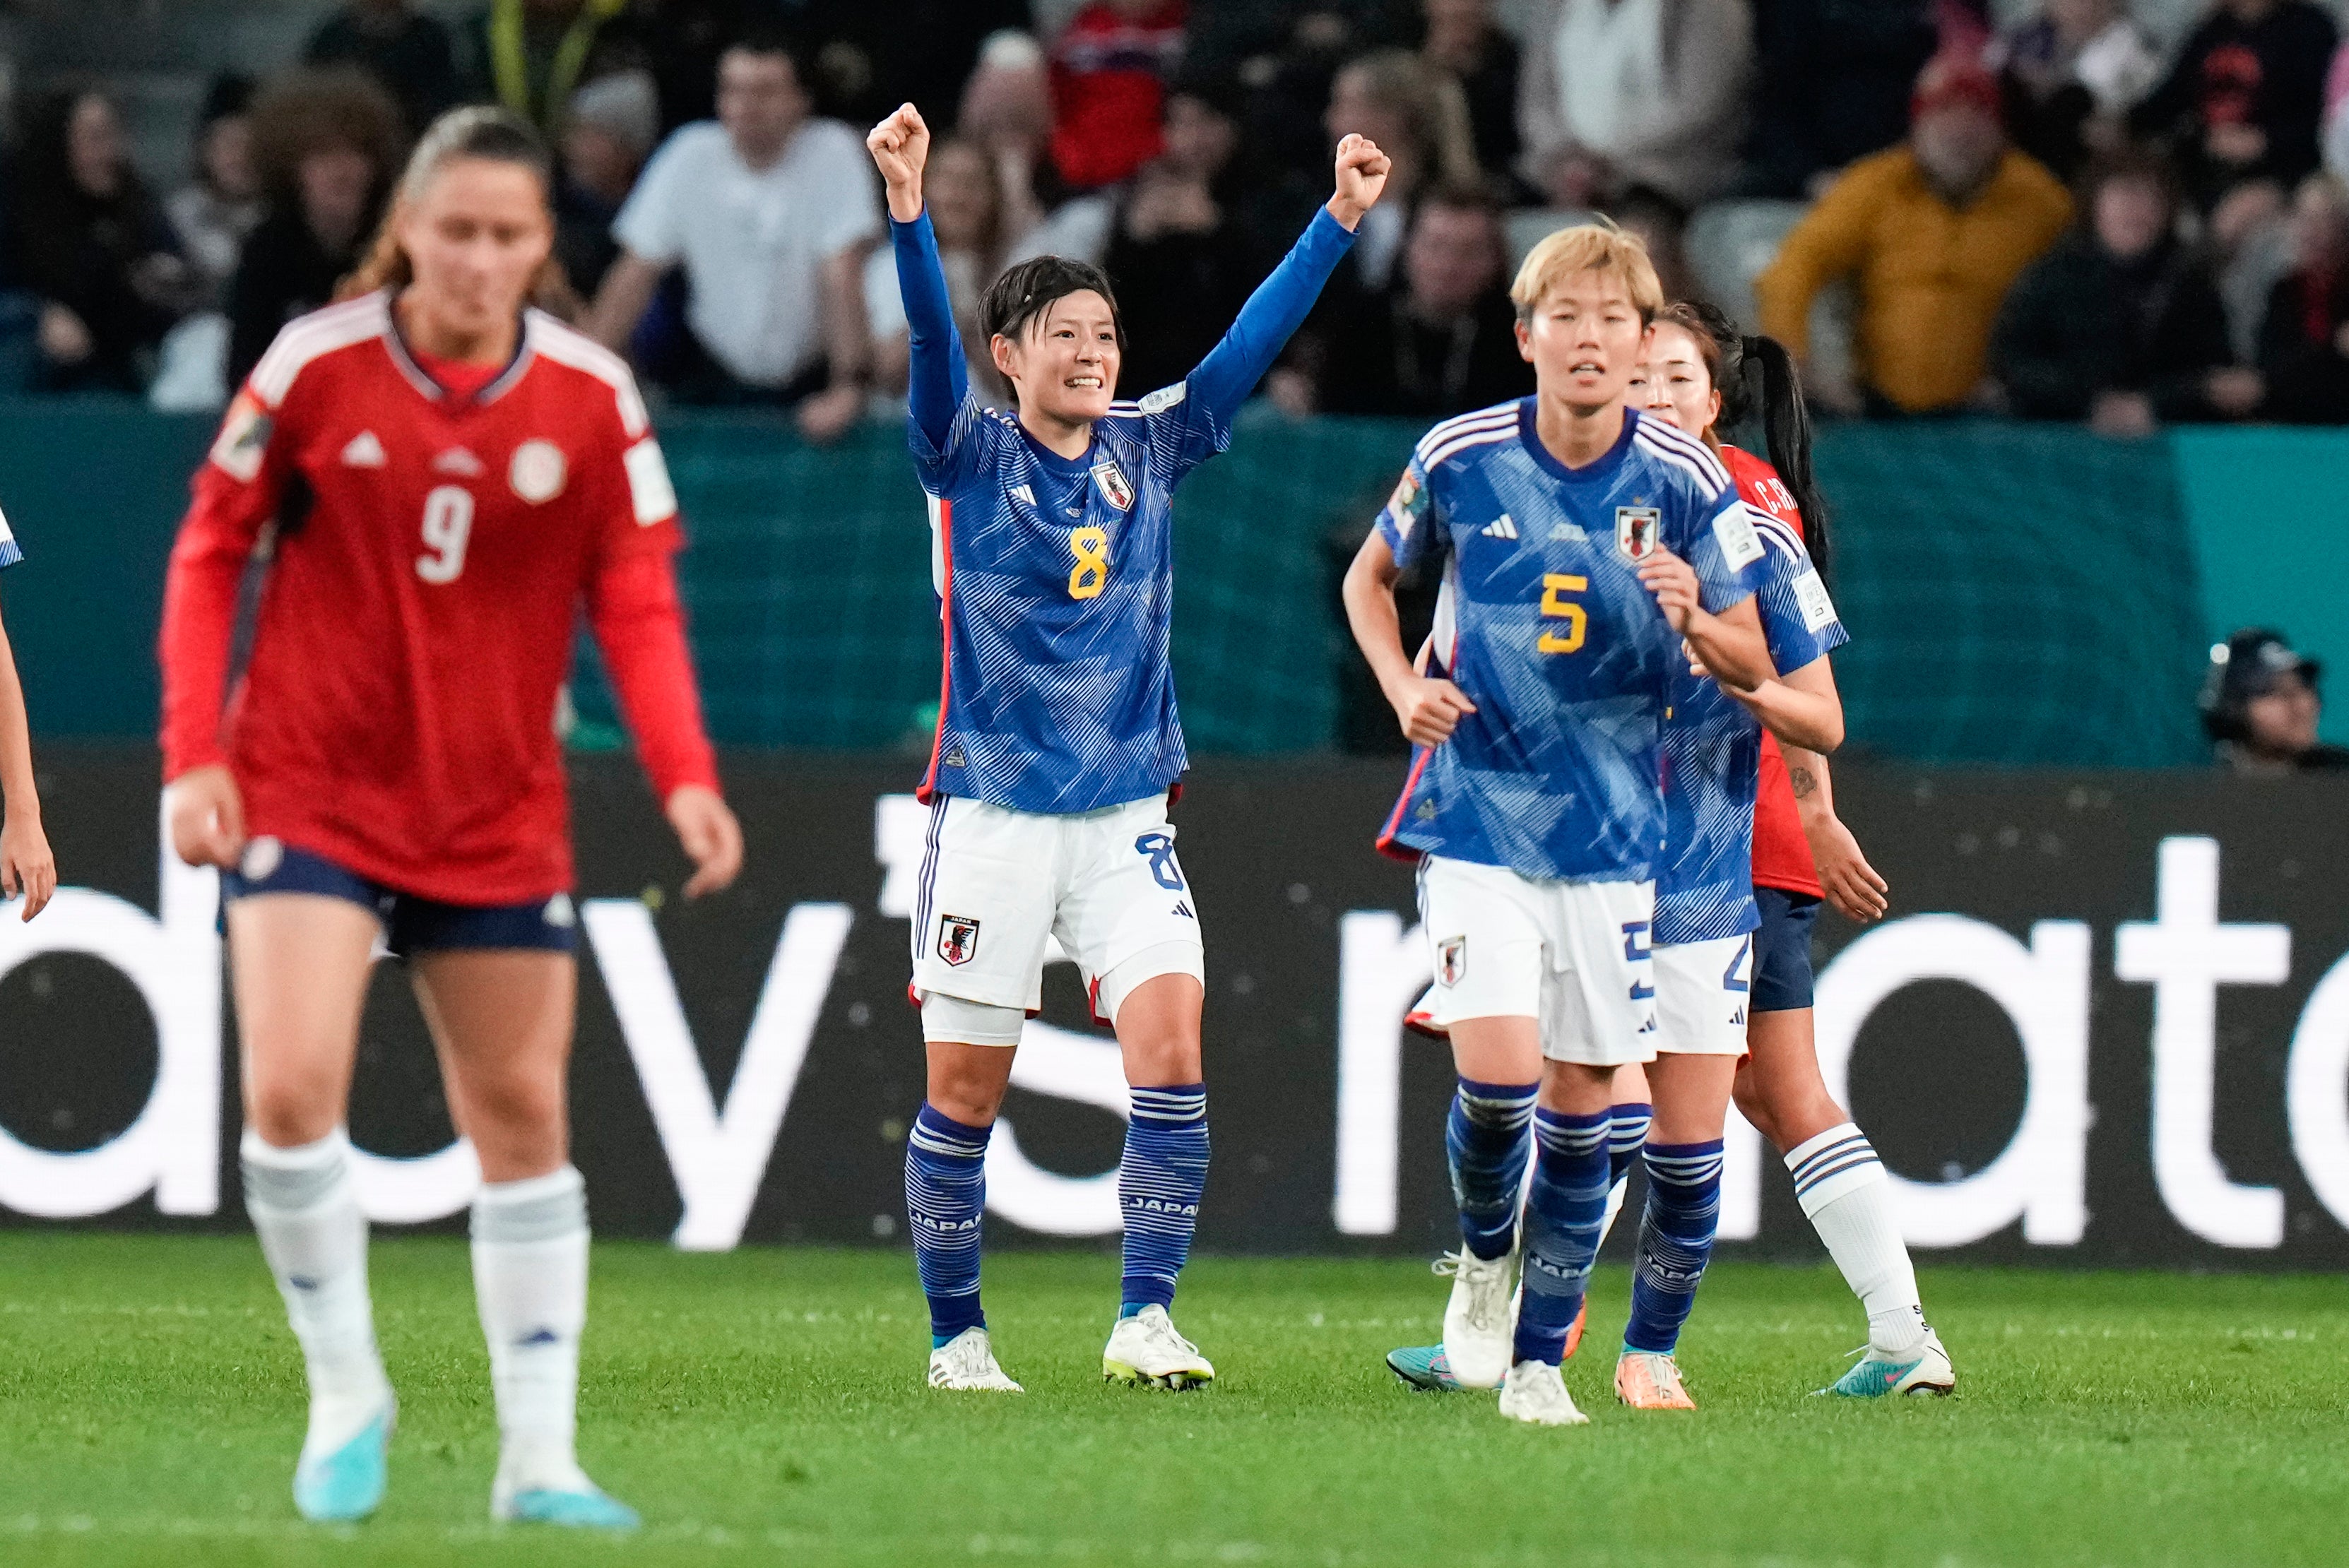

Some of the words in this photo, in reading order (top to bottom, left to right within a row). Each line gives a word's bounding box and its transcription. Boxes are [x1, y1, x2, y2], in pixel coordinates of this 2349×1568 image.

[415, 485, 475, 583] 9
[1068, 527, 1108, 600] 8
[1537, 573, 1588, 653] 5
[1135, 833, 1183, 891] 8
[950, 916, 972, 925] JAPAN
[1643, 1254, 1709, 1283] JAPA
